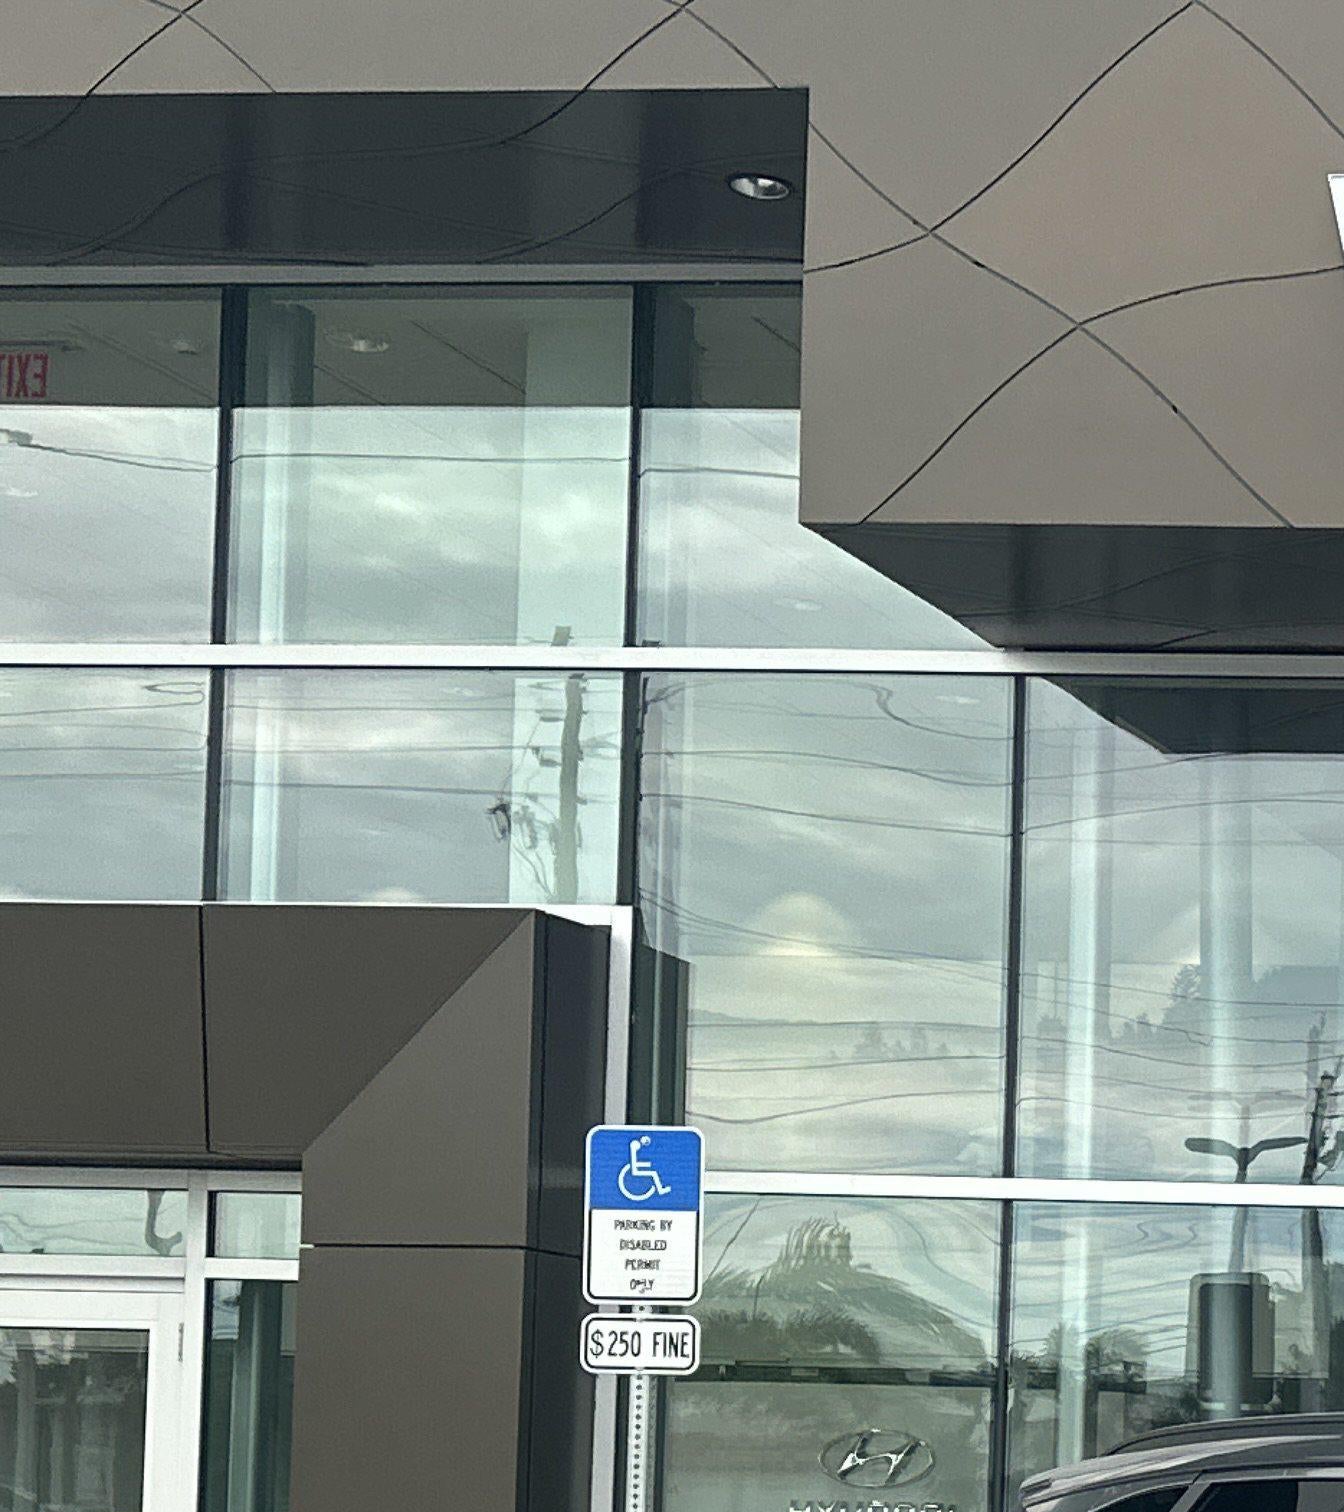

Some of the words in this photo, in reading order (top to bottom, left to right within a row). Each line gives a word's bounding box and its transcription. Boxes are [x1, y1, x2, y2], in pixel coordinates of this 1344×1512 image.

[613, 1219, 655, 1231] PARKING
[660, 1219, 673, 1231] BY
[619, 1239, 667, 1251] DISABLED
[590, 1329, 641, 1358] $250
[652, 1331, 690, 1358] FINE
